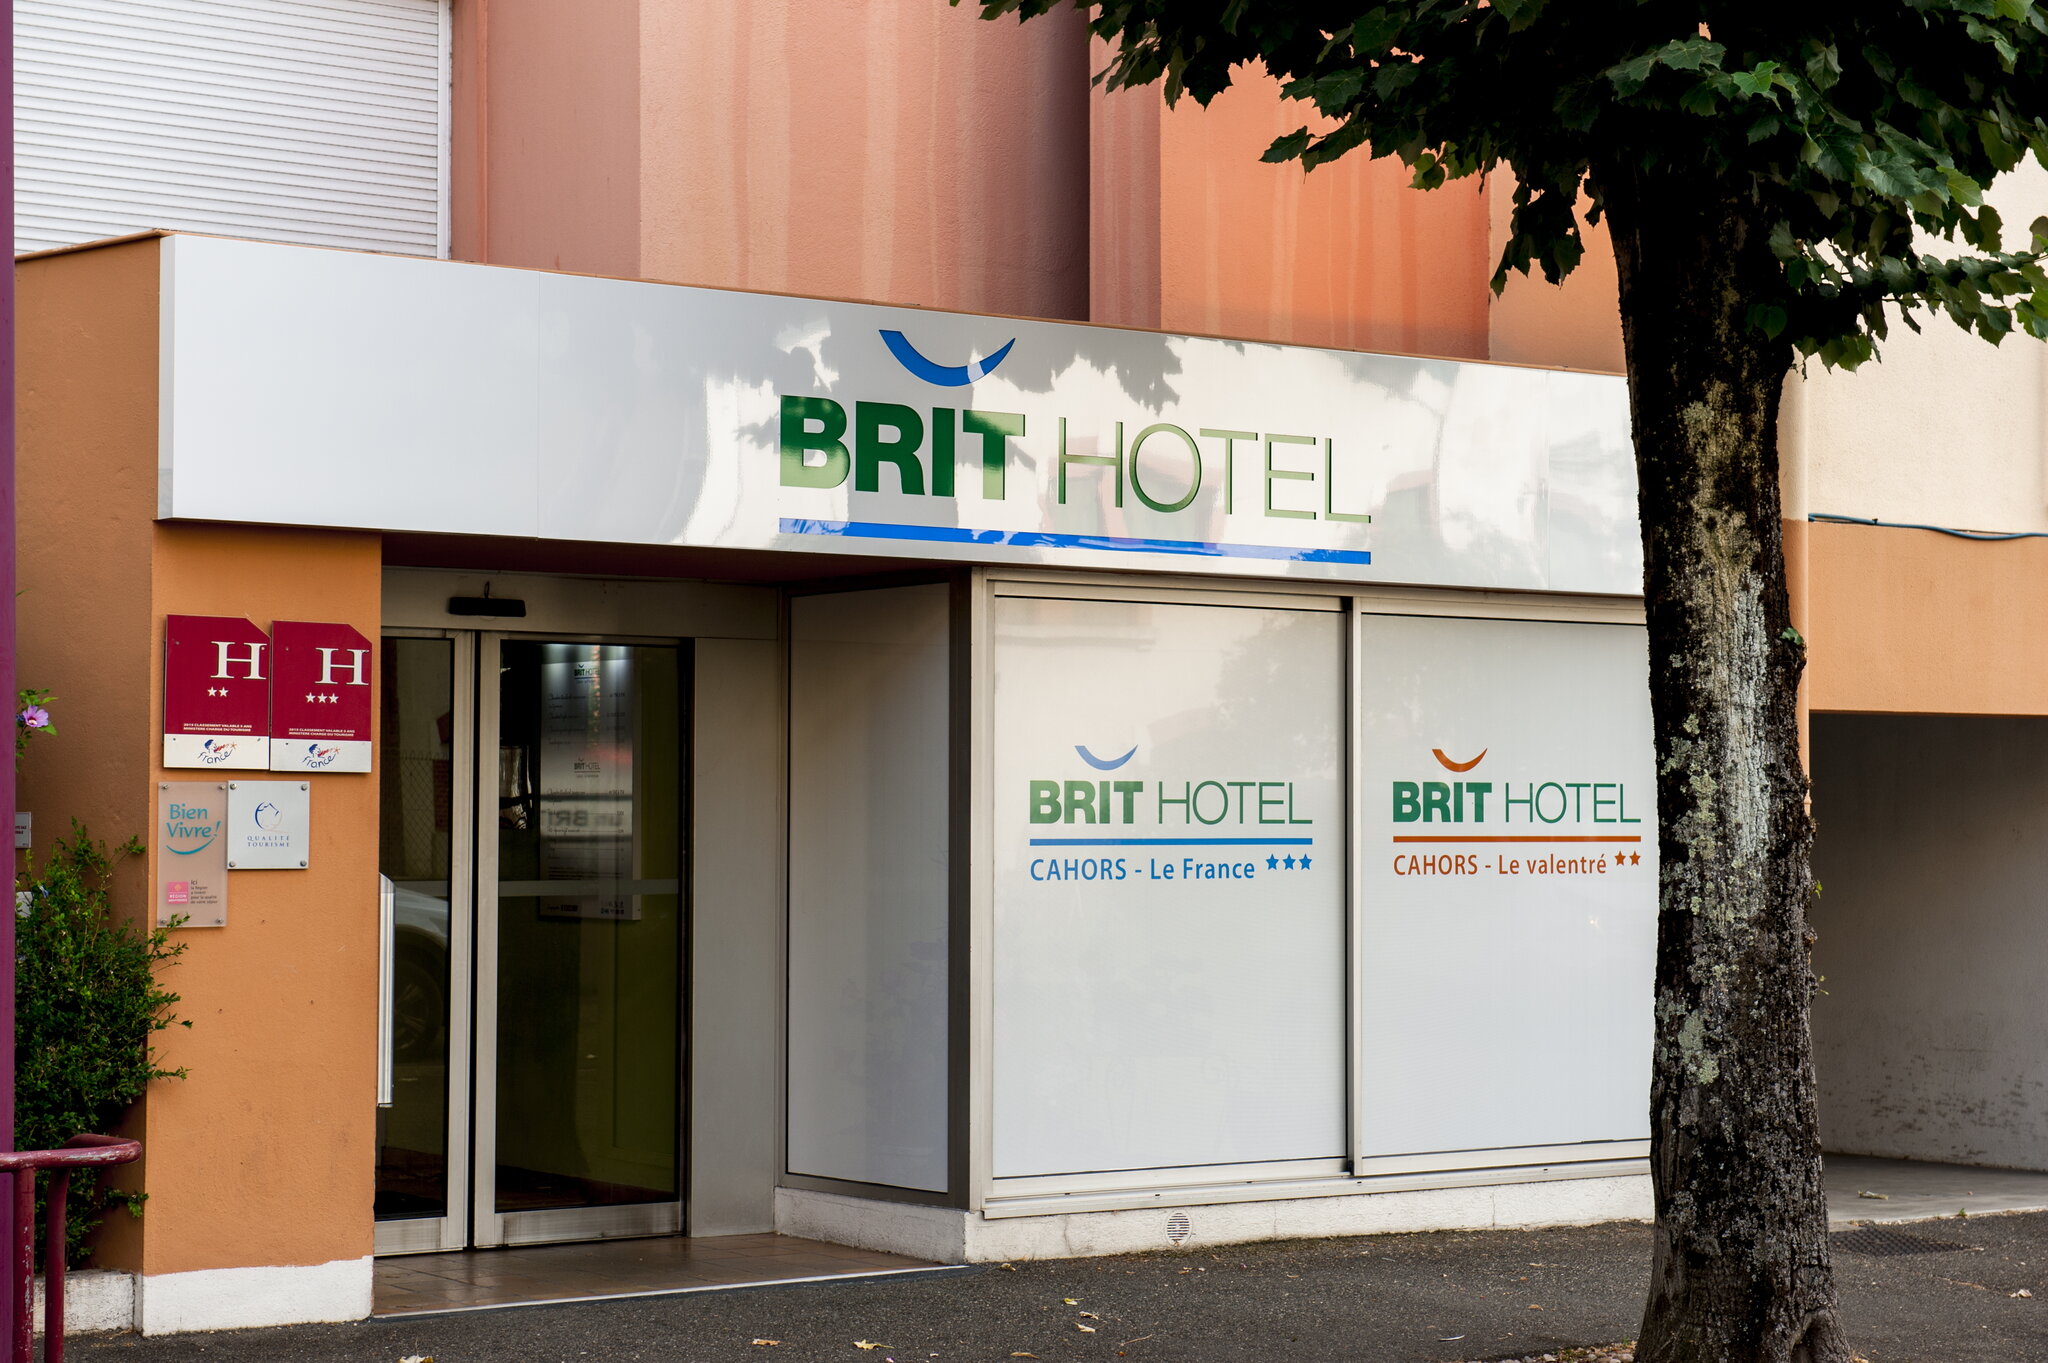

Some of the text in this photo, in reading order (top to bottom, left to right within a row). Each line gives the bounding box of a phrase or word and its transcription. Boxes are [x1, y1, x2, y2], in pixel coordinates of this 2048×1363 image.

[777, 394, 1371, 524] BRIT HOTEL
[210, 641, 268, 681] H
[314, 647, 369, 687] H
[169, 803, 208, 820] Bien
[1030, 780, 1312, 826] BRIT HOTEL
[1392, 781, 1642, 825] BRIT HOTEL
[1030, 858, 1128, 881] CAHORS
[1150, 858, 1176, 881] Le
[1182, 857, 1256, 881] France
[1392, 854, 1479, 876] CAHORS
[1497, 854, 1521, 876] Le
[1526, 853, 1607, 876] valentré
